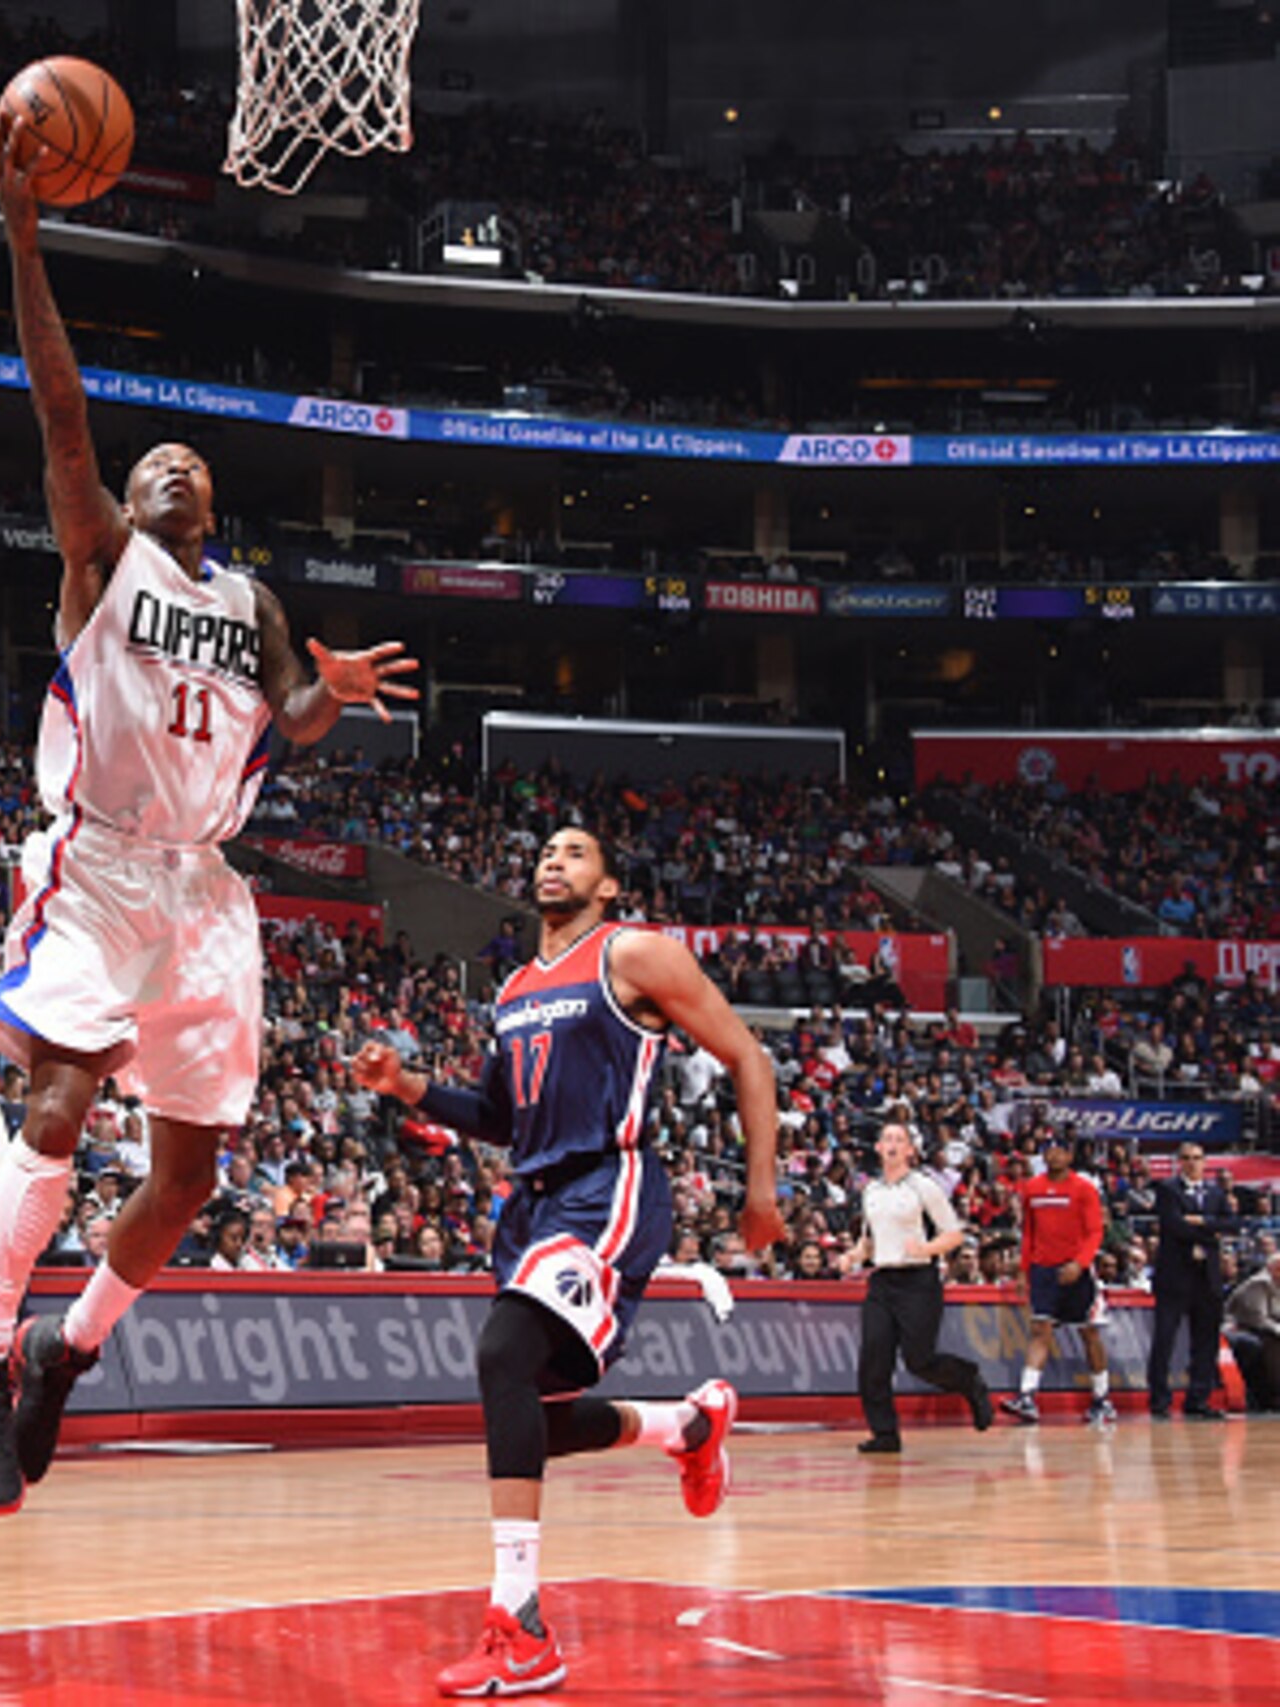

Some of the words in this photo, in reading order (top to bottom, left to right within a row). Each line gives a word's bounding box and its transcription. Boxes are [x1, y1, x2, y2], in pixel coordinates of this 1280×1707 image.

[105, 374, 121, 394] of
[125, 376, 153, 400] the
[159, 383, 182, 403] LA
[305, 403, 372, 429] ARCO
[440, 418, 505, 440] Official
[509, 422, 584, 446] Gasoline
[589, 428, 609, 447] of
[611, 428, 639, 450] the
[644, 432, 668, 452] LA
[796, 439, 871, 461] ARCO
[947, 442, 1014, 459] Official
[1167, 440, 1196, 459] LA
[707, 585, 817, 613] TOSHIBA
[1184, 593, 1278, 610] DELTA
[129, 589, 261, 681] CLIPPERS
[168, 681, 213, 743] 11
[510, 1031, 552, 1108] 17
[1118, 1107, 1221, 1132] LIGHT
[126, 1294, 367, 1401] bright
[377, 1294, 480, 1382] sid
[719, 1302, 860, 1390] buyin
